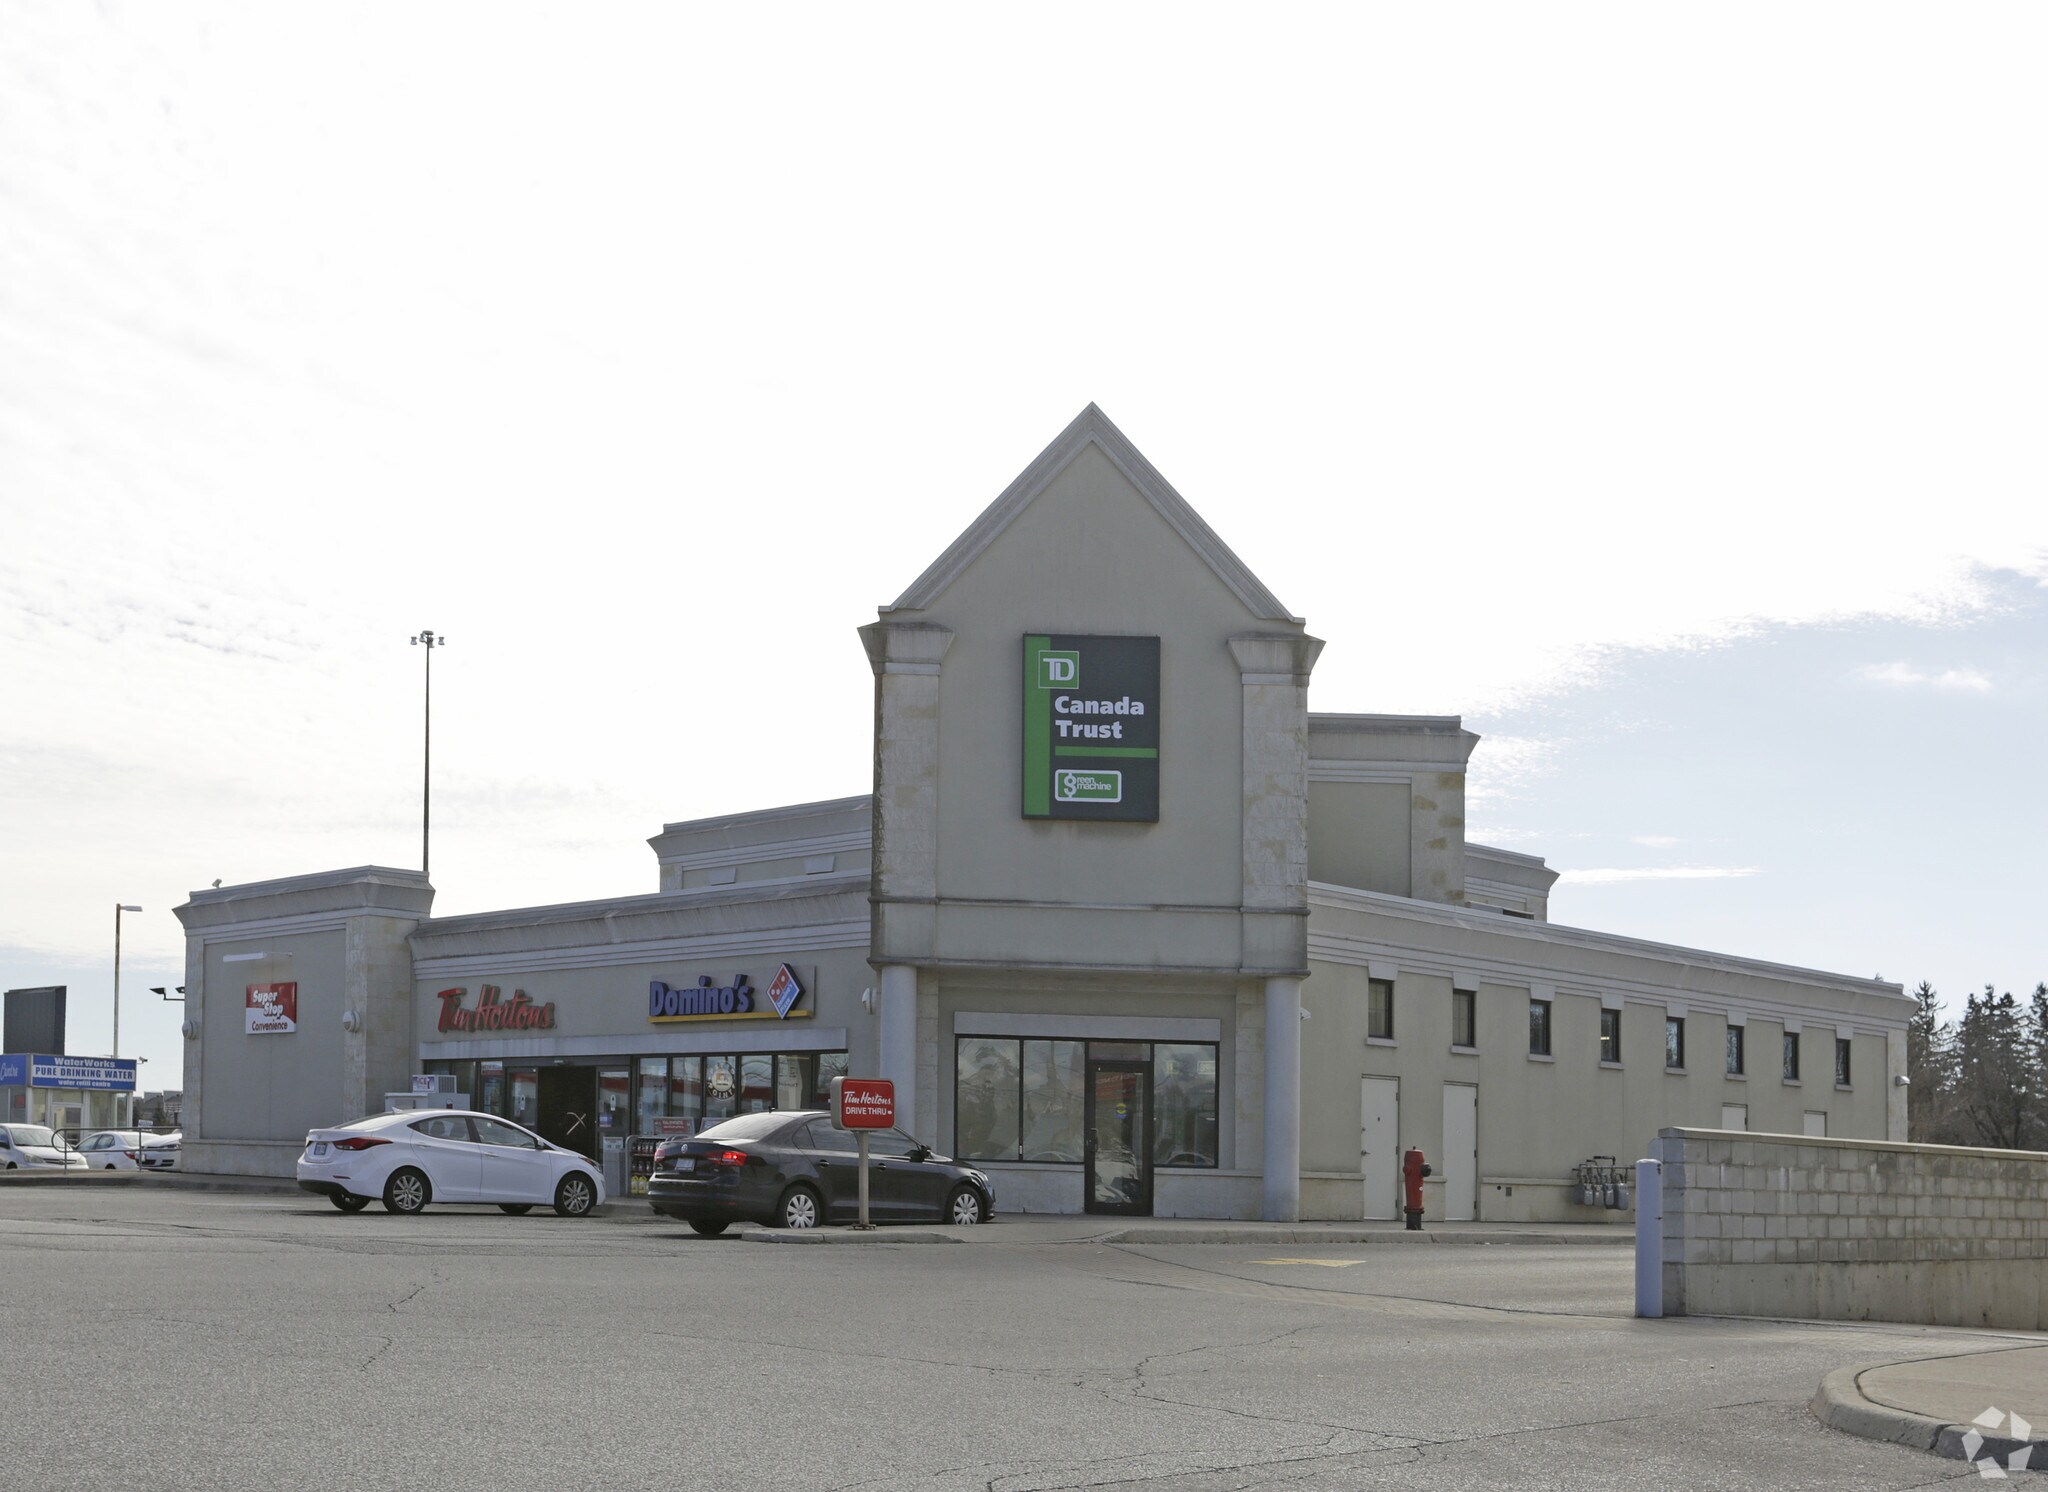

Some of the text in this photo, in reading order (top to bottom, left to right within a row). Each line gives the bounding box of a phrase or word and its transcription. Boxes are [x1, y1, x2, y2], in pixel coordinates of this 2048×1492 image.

[1043, 658, 1075, 681] TD
[1054, 695, 1145, 715] Canada
[1055, 720, 1123, 739] Trust
[1076, 782, 1112, 791] machine
[252, 989, 278, 1005] Super
[649, 974, 755, 1017] Domino's
[263, 1002, 284, 1019] Stop
[437, 984, 555, 1033] Tim Hortons
[251, 1020, 288, 1031] Convenience
[54, 1057, 116, 1068] WaterWorks
[35, 1066, 133, 1079] PURE DRINKING WATER
[844, 1091, 892, 1105] Tim Hortons
[845, 1106, 887, 1115] DRIVE THRU
